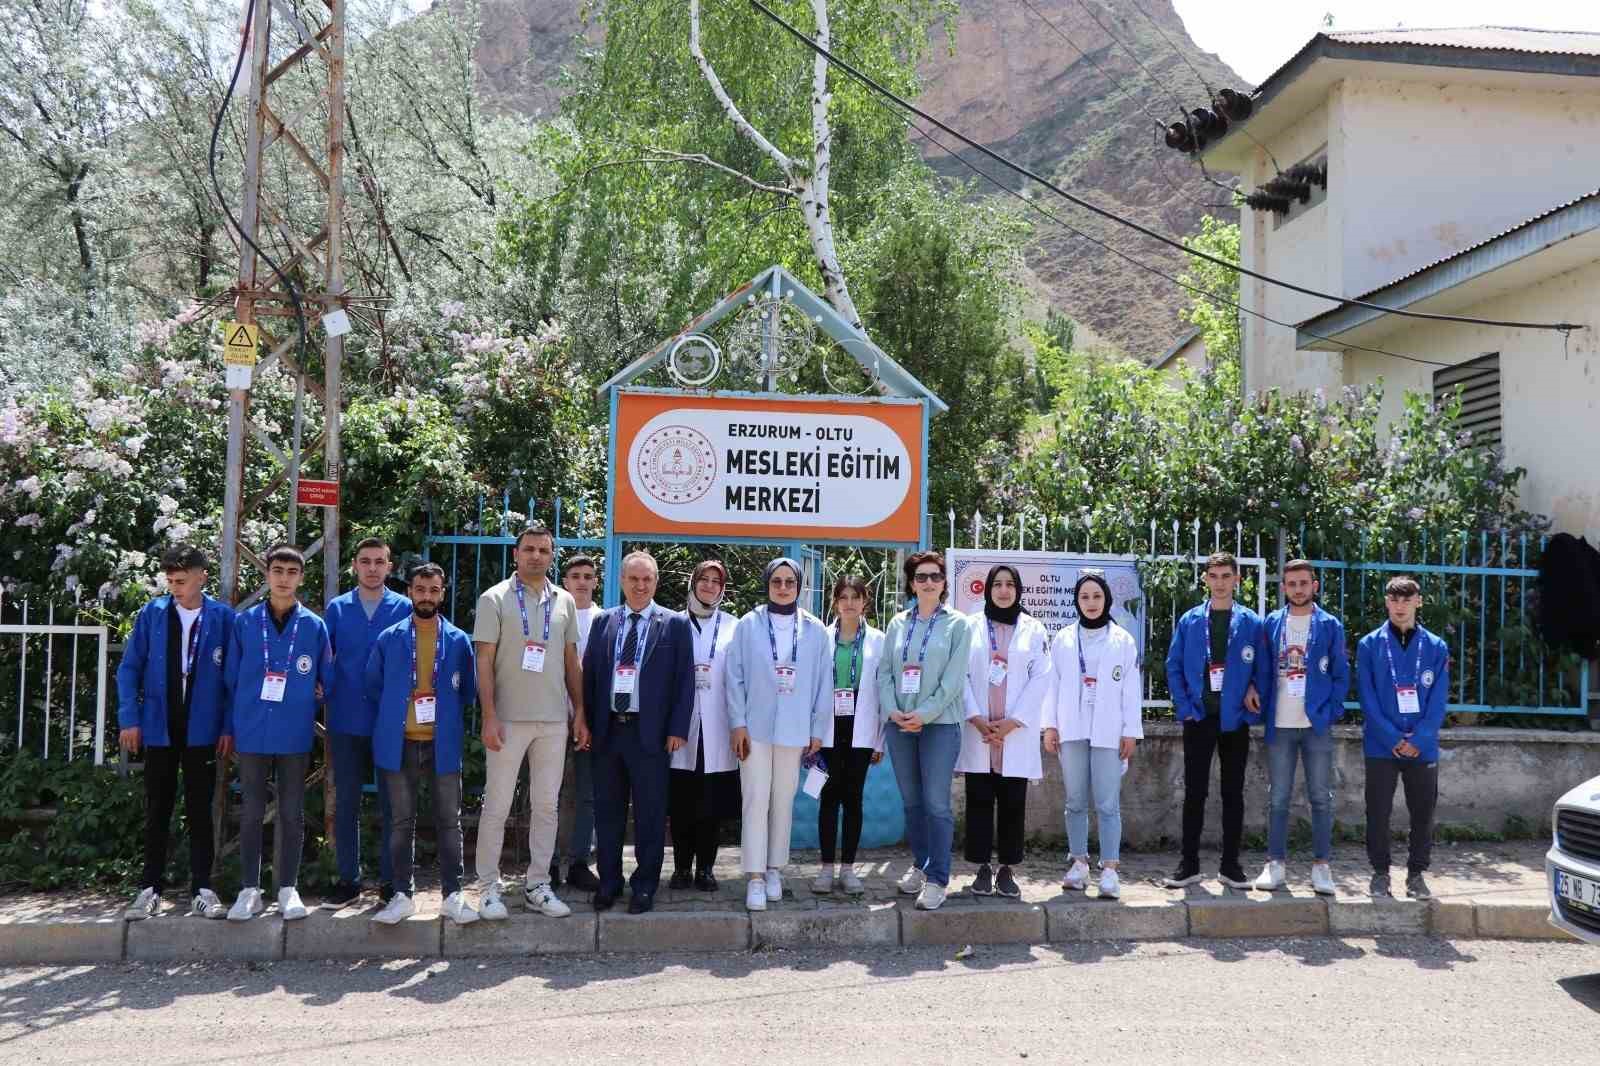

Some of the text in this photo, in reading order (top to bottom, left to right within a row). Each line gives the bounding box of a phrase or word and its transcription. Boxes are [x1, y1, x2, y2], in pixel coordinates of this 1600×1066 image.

[728, 423, 801, 439] ERZURUM
[815, 426, 853, 442] OLTU
[726, 445, 820, 477] MESLEKİ
[827, 446, 900, 480] EĞİTİM
[725, 481, 820, 514] MERKEZİ
[1040, 574, 1060, 582] OLTU
[1027, 598, 1059, 607] ULUSAL
